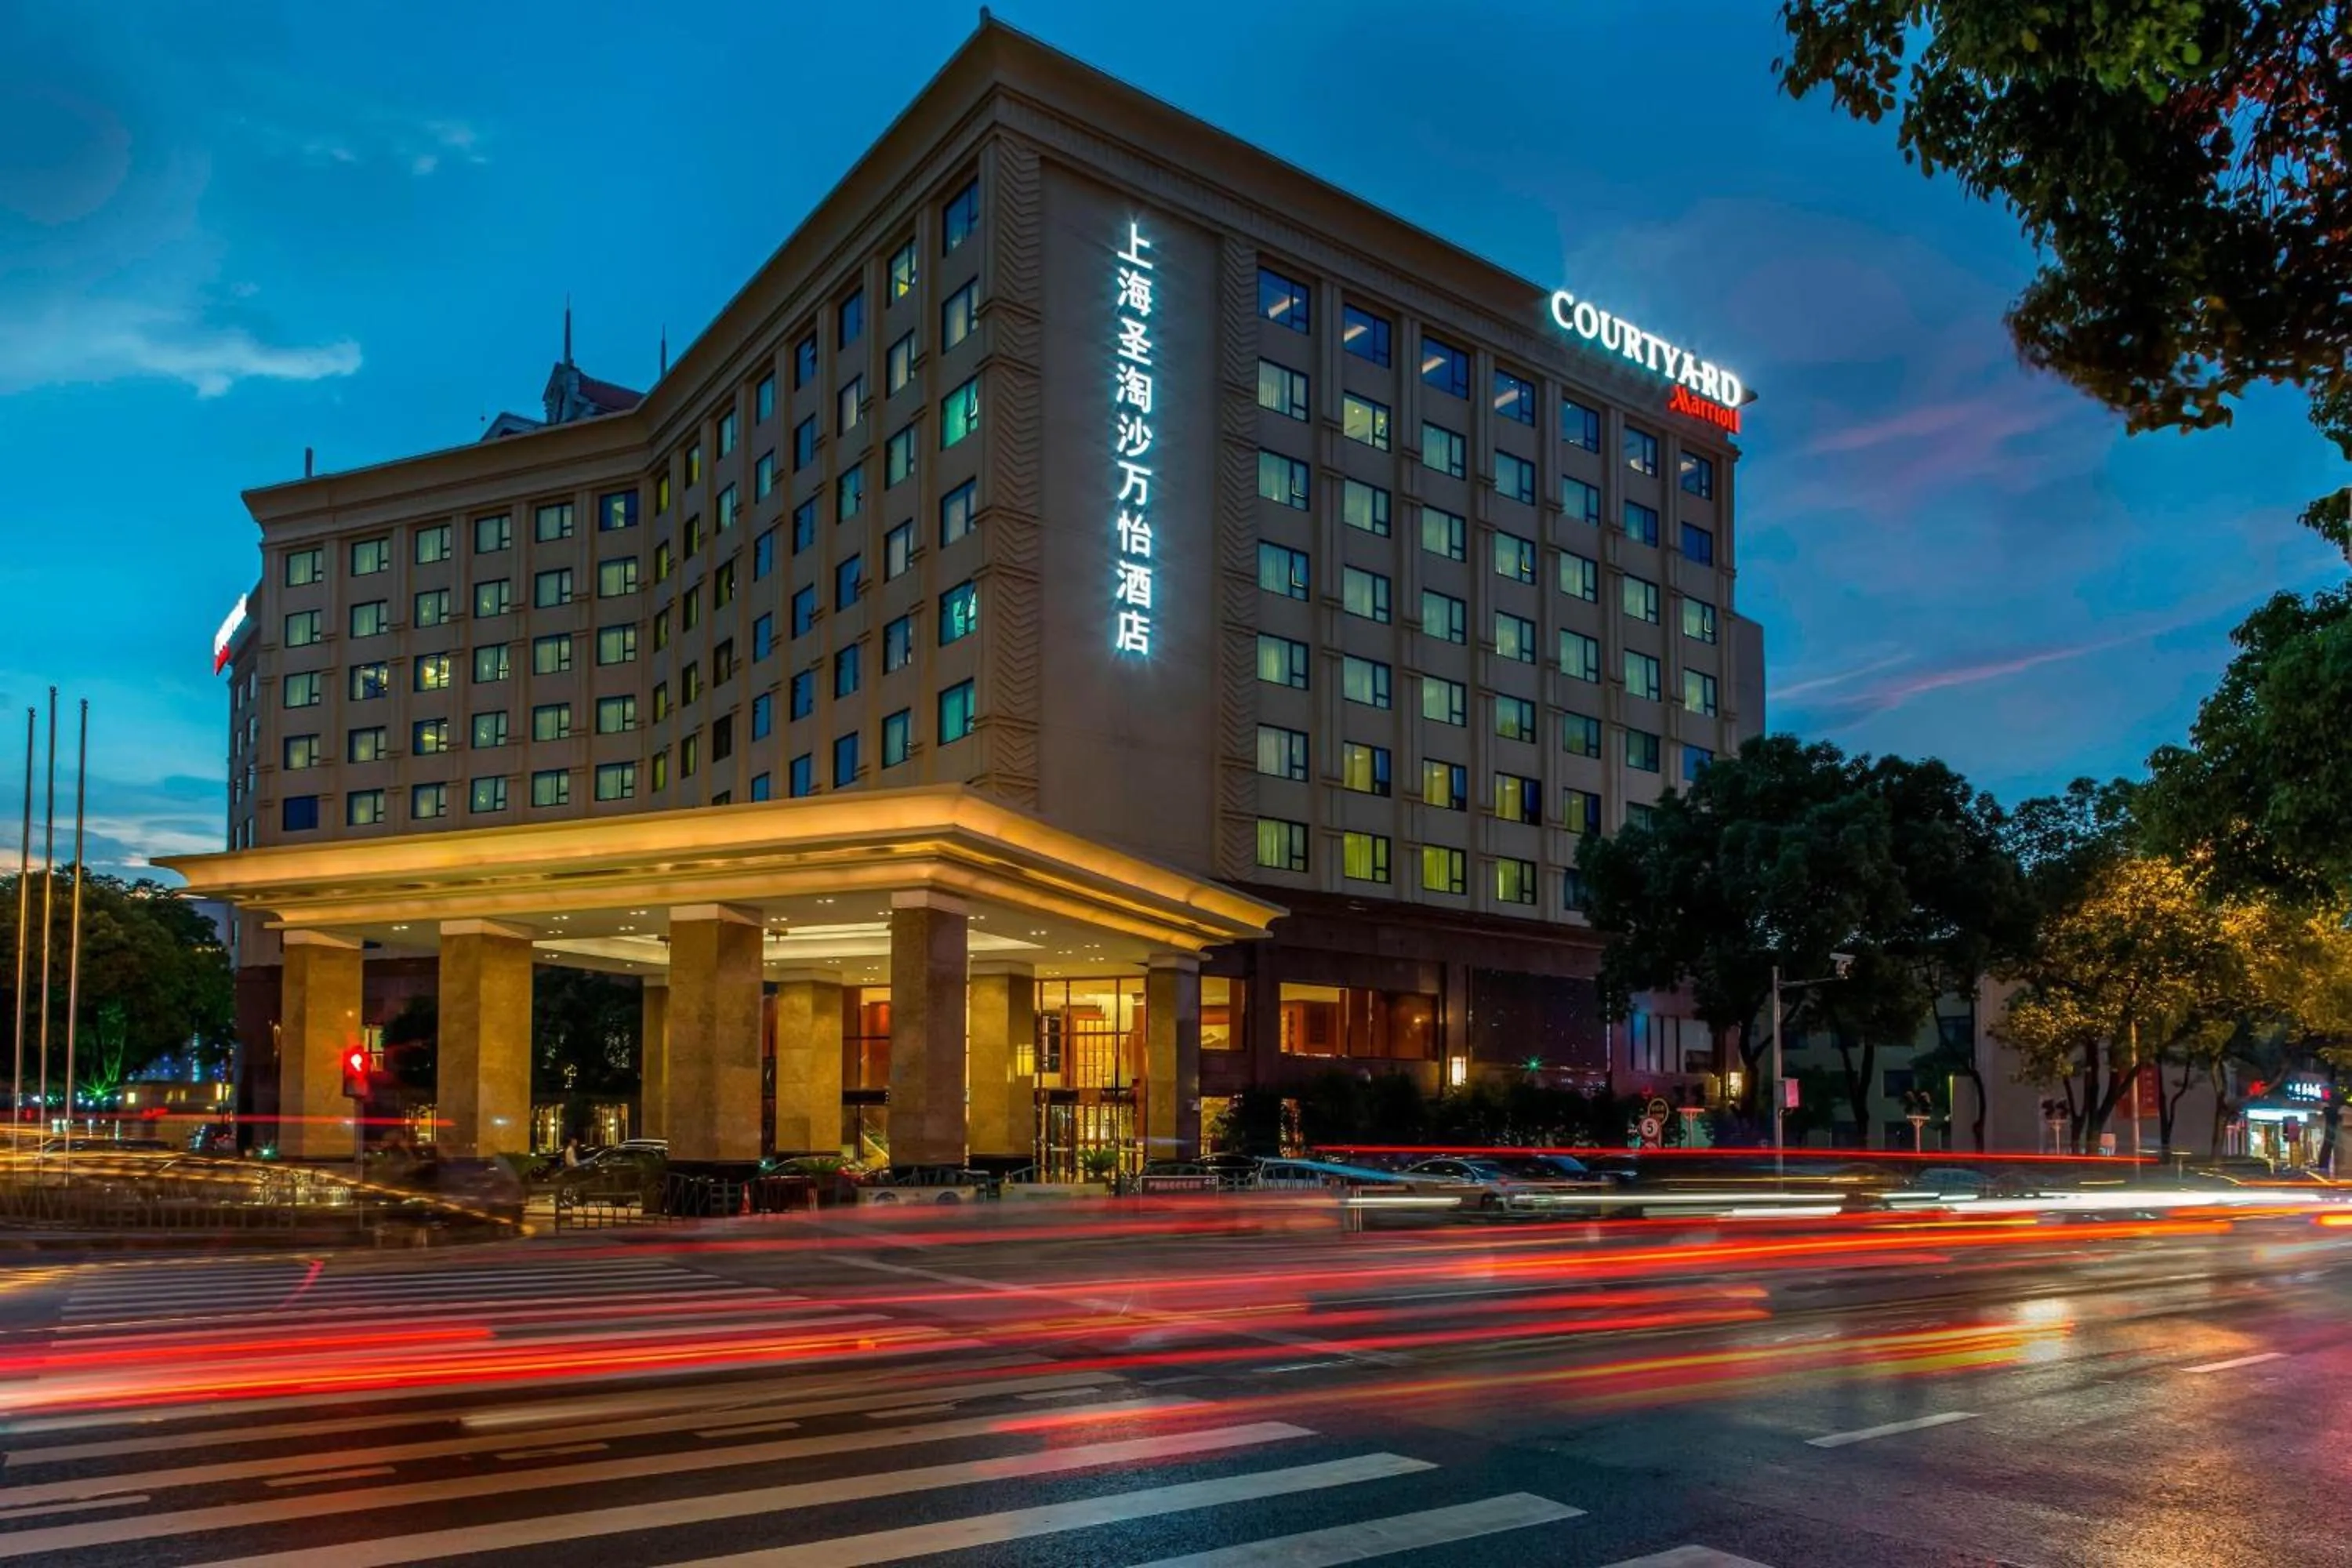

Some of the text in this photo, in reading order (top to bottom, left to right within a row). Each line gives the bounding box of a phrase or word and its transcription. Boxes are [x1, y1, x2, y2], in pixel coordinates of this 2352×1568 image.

[1551, 290, 1742, 408] COURTYARD
[1116, 223, 1153, 655] 上海圣淘沙万怡酒店
[1668, 383, 1741, 434] Marriott
